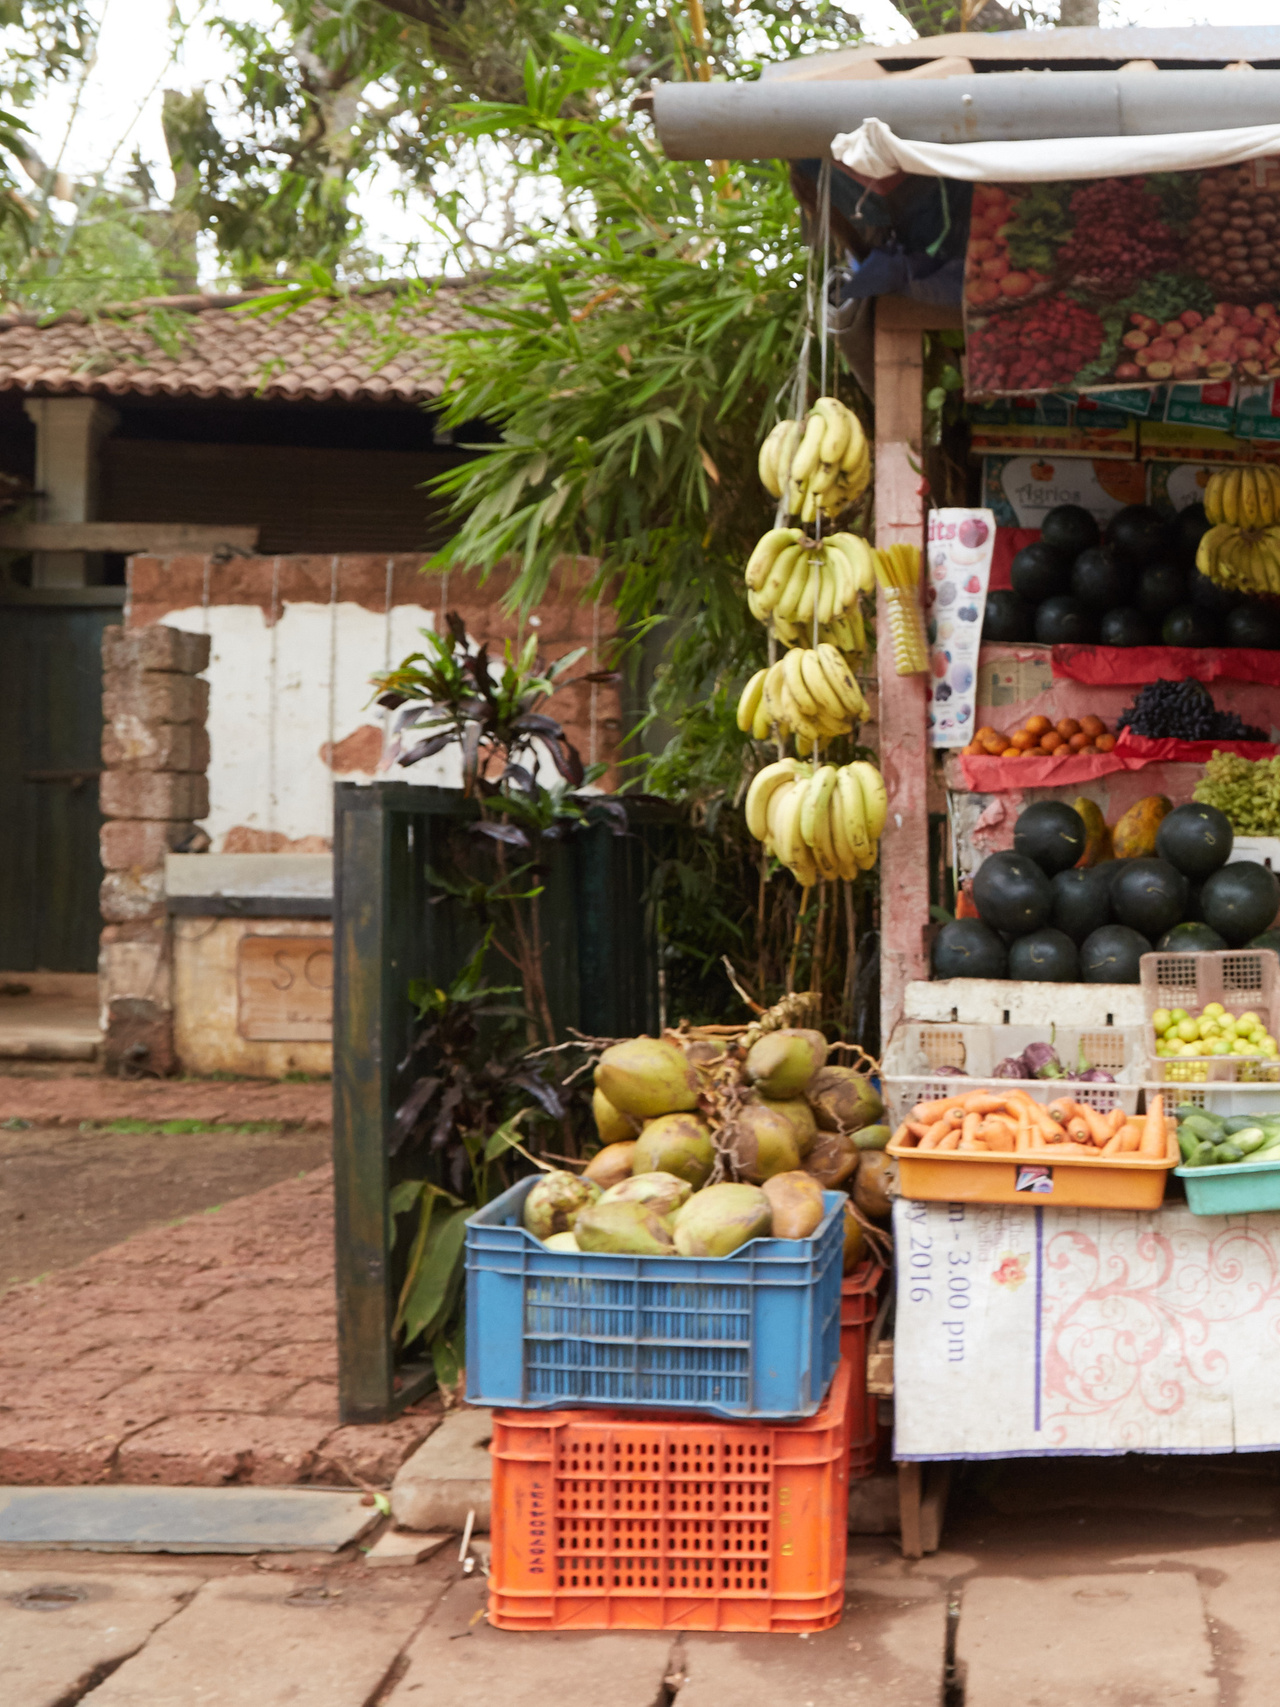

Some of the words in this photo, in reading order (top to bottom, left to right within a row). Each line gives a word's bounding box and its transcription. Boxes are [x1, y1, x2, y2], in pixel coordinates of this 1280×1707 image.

[910, 1236, 933, 1303] 2016
[948, 1252, 971, 1310] 3.00
[942, 1321, 965, 1362] pm
